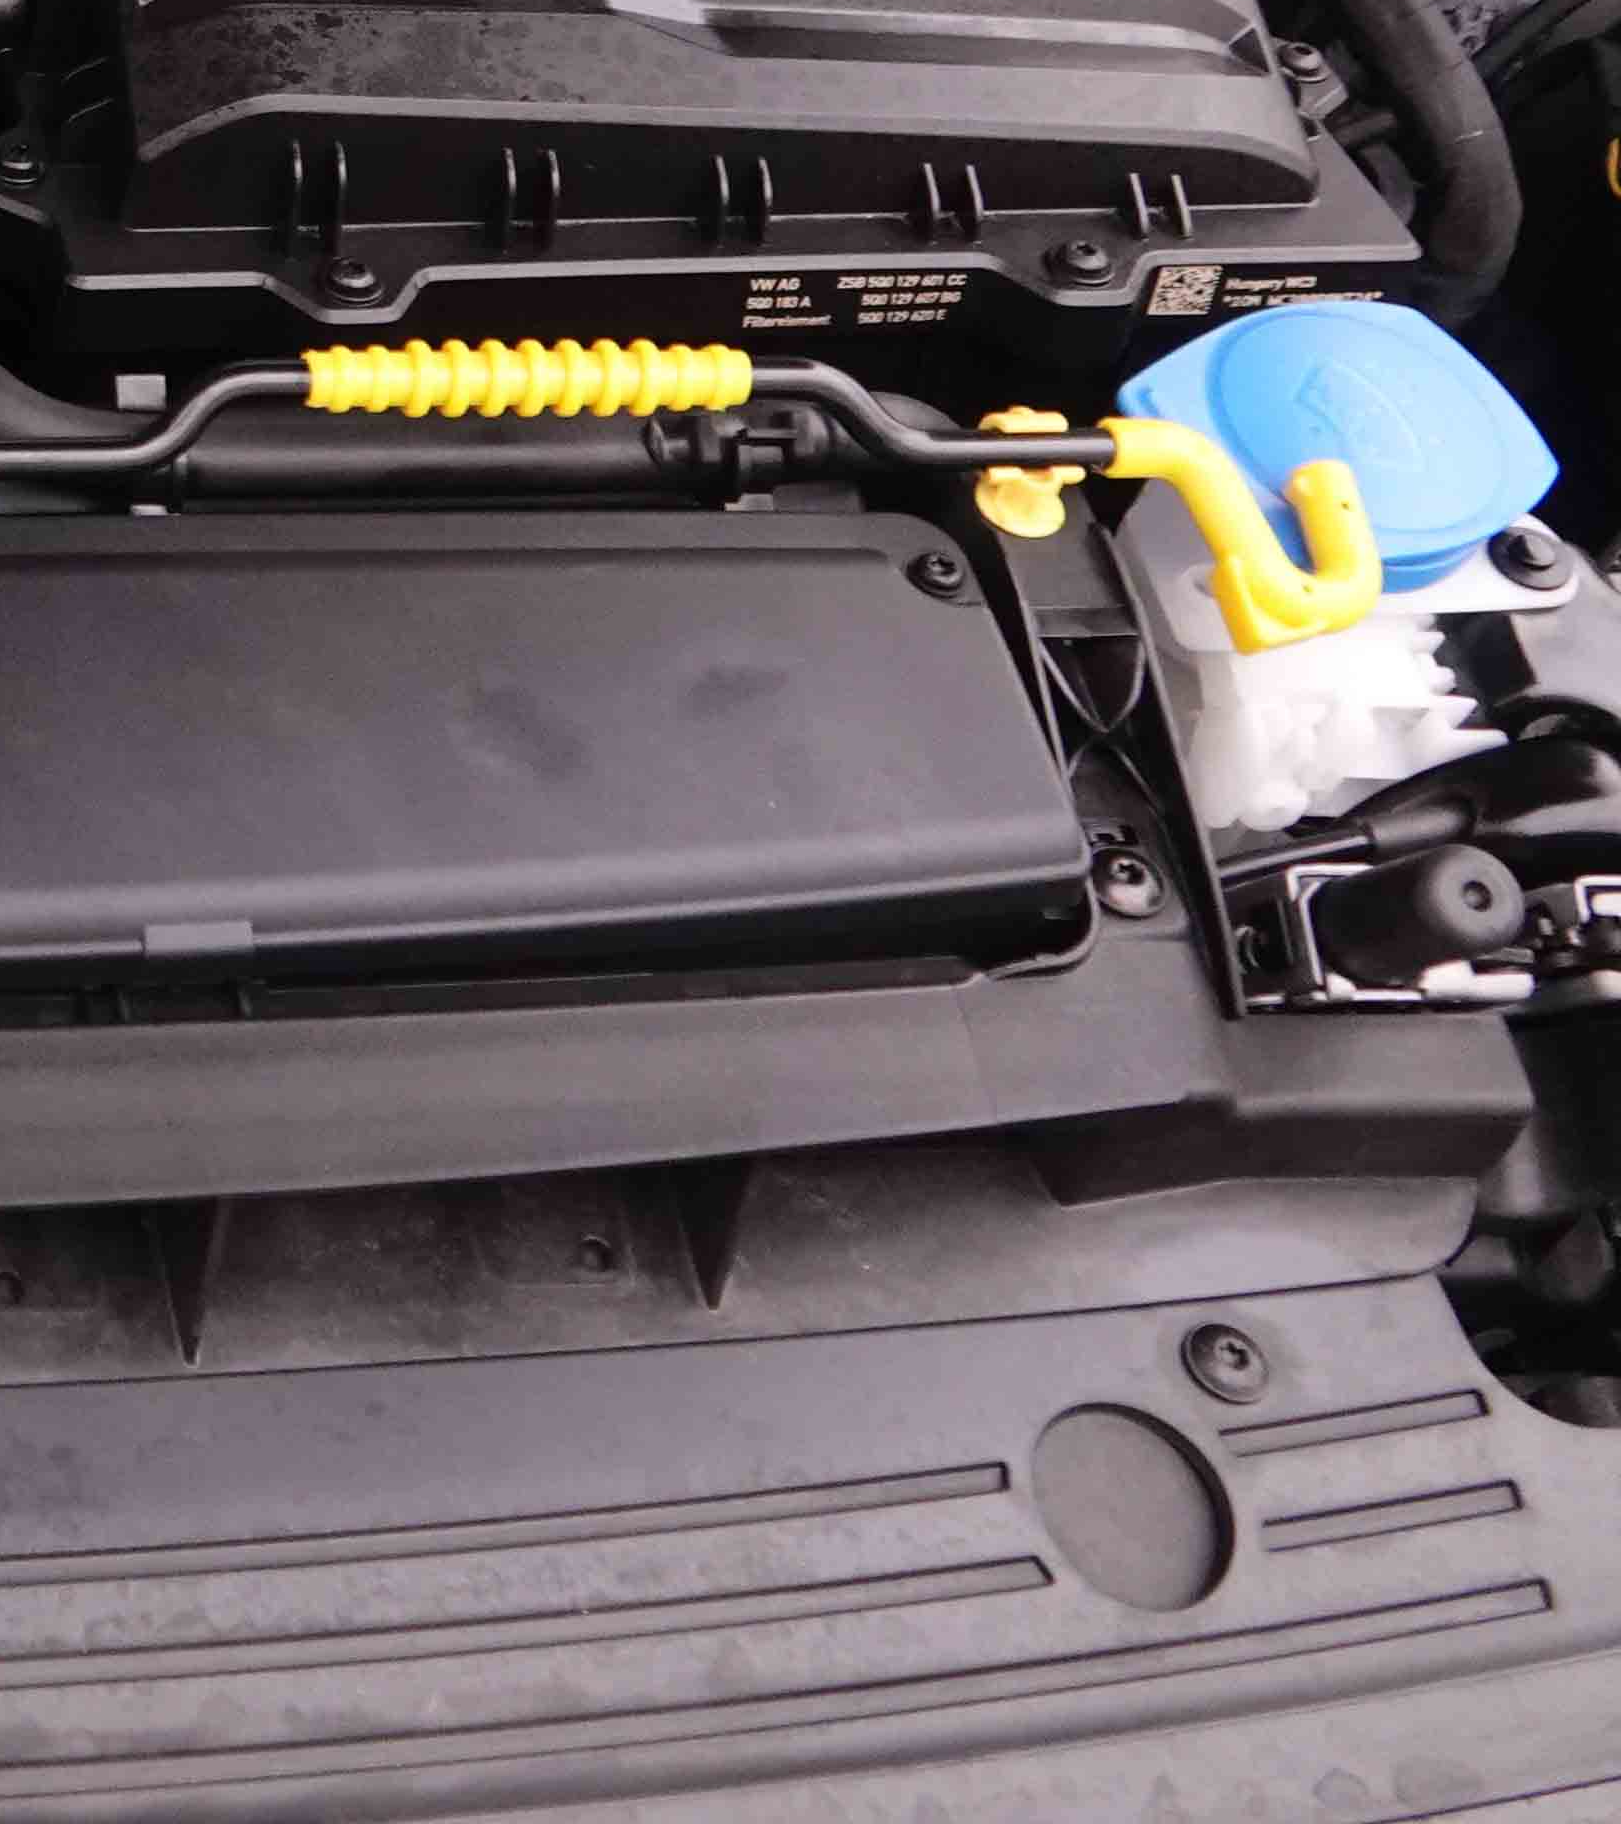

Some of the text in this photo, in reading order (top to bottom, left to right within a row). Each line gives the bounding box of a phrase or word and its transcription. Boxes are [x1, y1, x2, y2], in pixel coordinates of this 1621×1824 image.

[750, 277, 801, 292] VW AG
[799, 295, 812, 308] A
